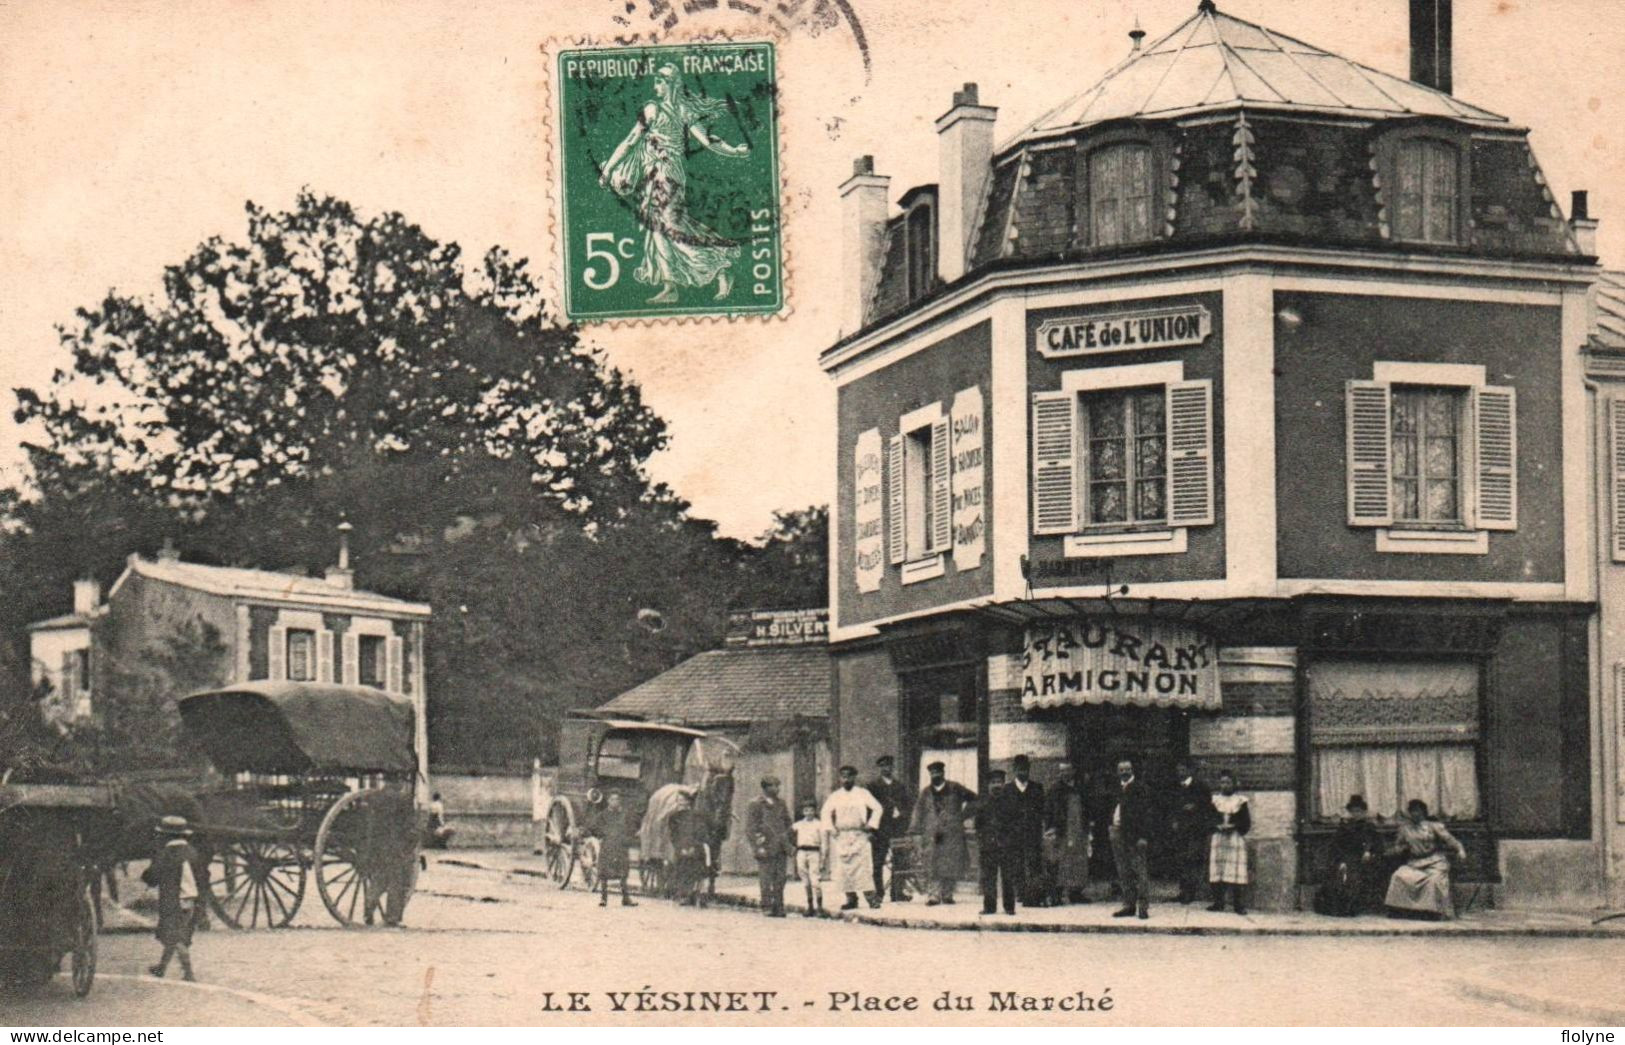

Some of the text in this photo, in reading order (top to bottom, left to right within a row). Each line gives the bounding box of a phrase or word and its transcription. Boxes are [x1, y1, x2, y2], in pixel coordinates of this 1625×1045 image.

[751, 208, 772, 295] POSTES
[1047, 314, 1200, 351] CAFÉ de L'UNION
